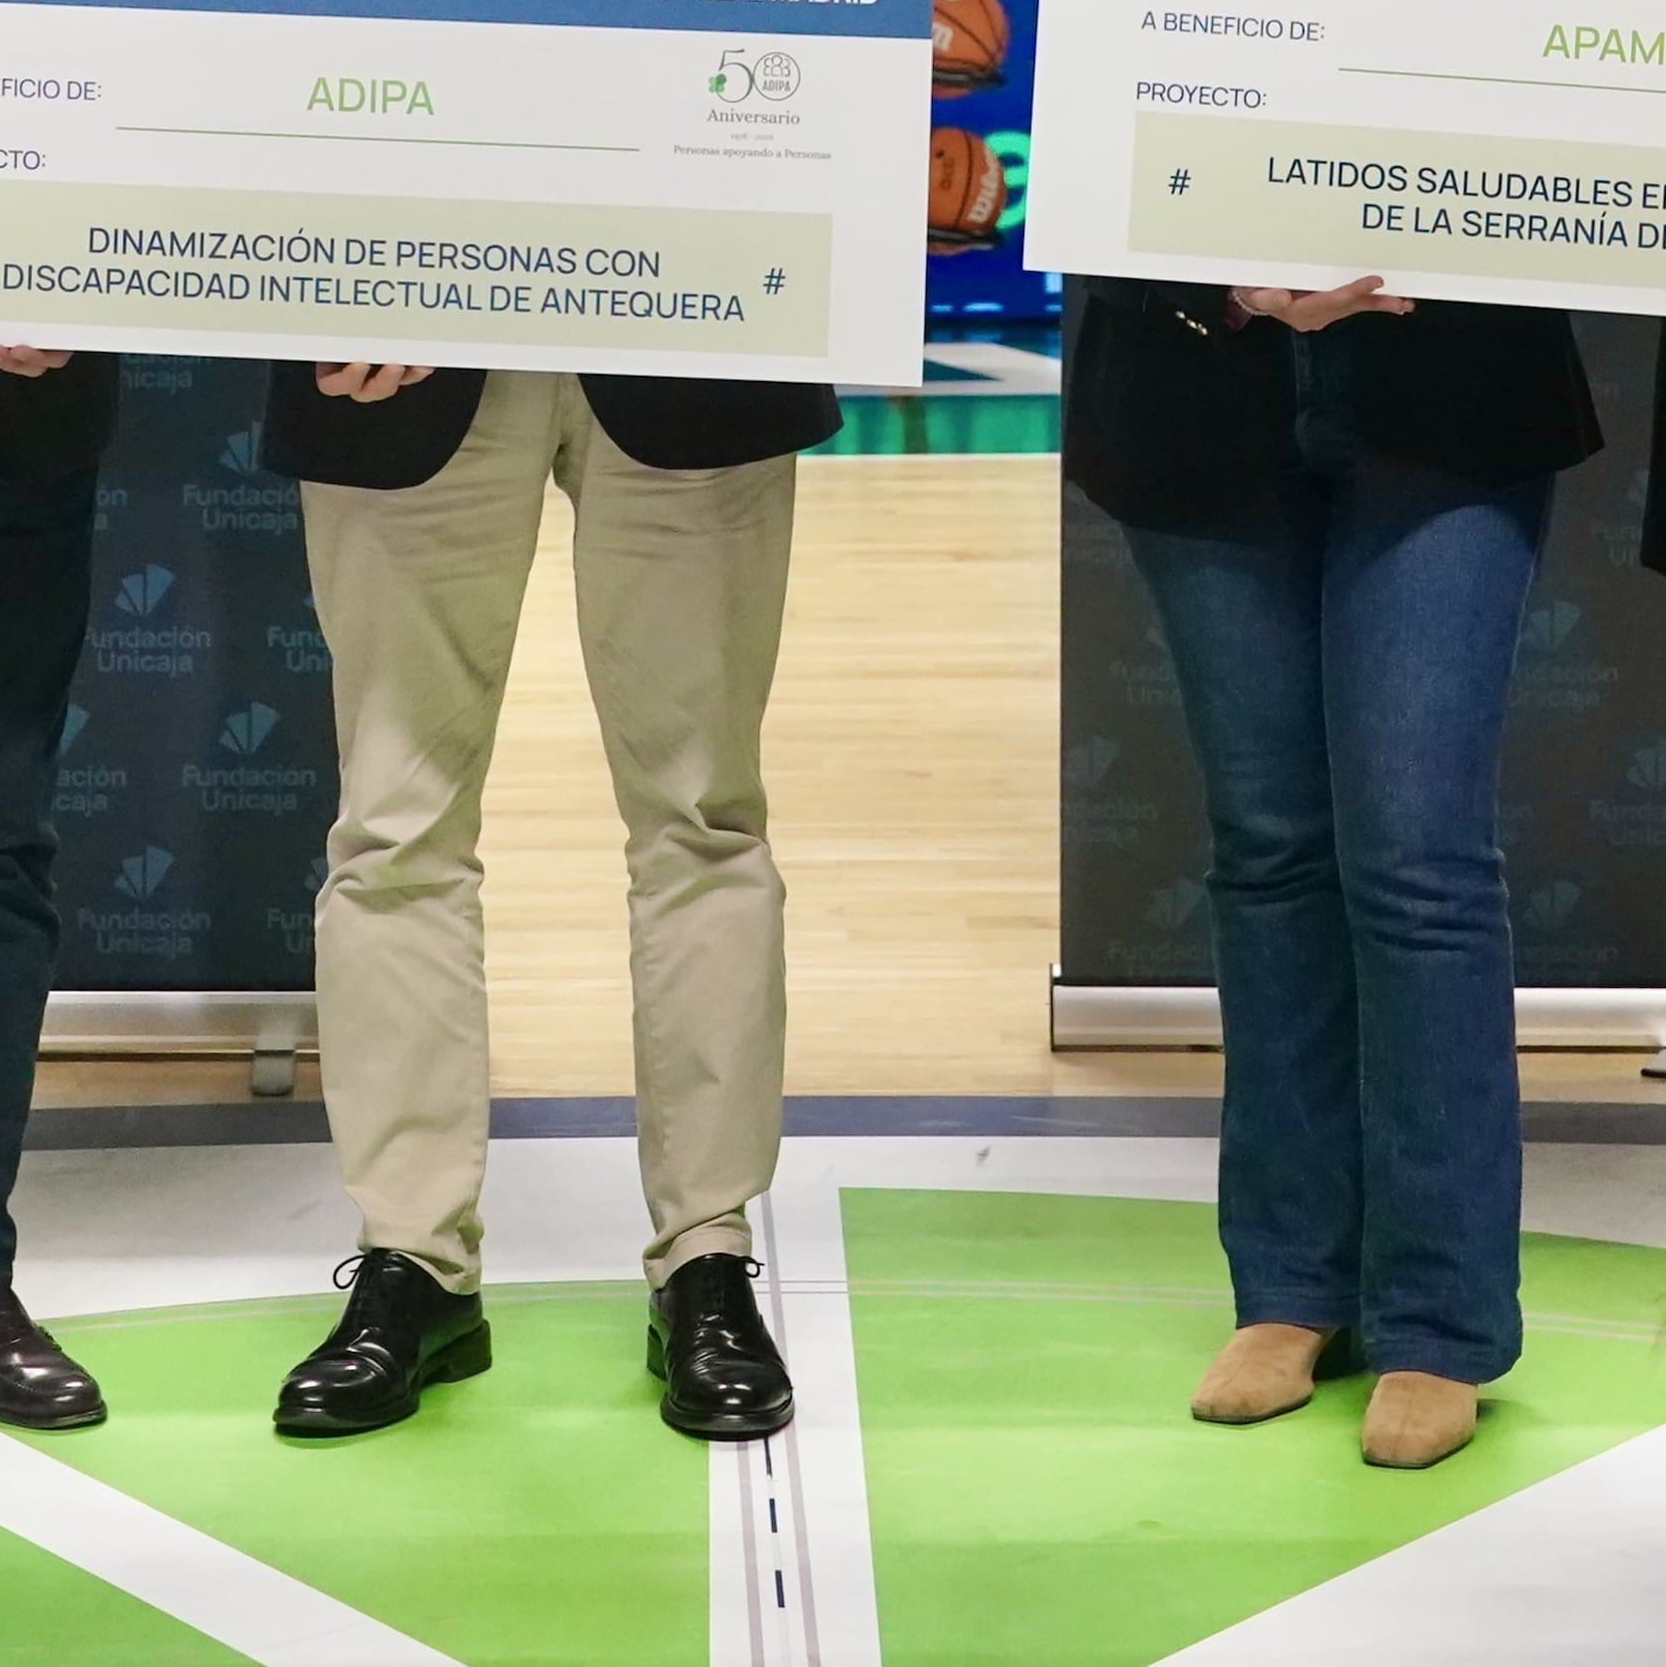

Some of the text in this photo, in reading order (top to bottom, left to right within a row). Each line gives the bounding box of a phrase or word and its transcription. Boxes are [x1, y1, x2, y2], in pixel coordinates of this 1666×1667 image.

[1141, 11, 1324, 41] A BENEFICIO DE:
[1543, 24, 1665, 65] APAM
[67, 80, 101, 100] DE:
[307, 77, 434, 115] ADIPA
[761, 79, 791, 92] ADIPA
[1136, 81, 1266, 108] PROYECTO:
[706, 107, 801, 125] Aniversario
[1268, 157, 1407, 191] LATIDOS
[1417, 167, 1632, 207] SALUDABLES
[1362, 203, 1404, 231] DE
[1414, 207, 1452, 234] LA
[1462, 210, 1628, 246] SERRANÍA
[89, 227, 659, 277] DINAMIZACIÓN DE PERSONAS CON
[3, 263, 744, 321] DISCAPACIDAD INTELECTUAL DE ANTEQUERA
[183, 766, 316, 789] Fundación
[202, 791, 298, 816] Unicaja
